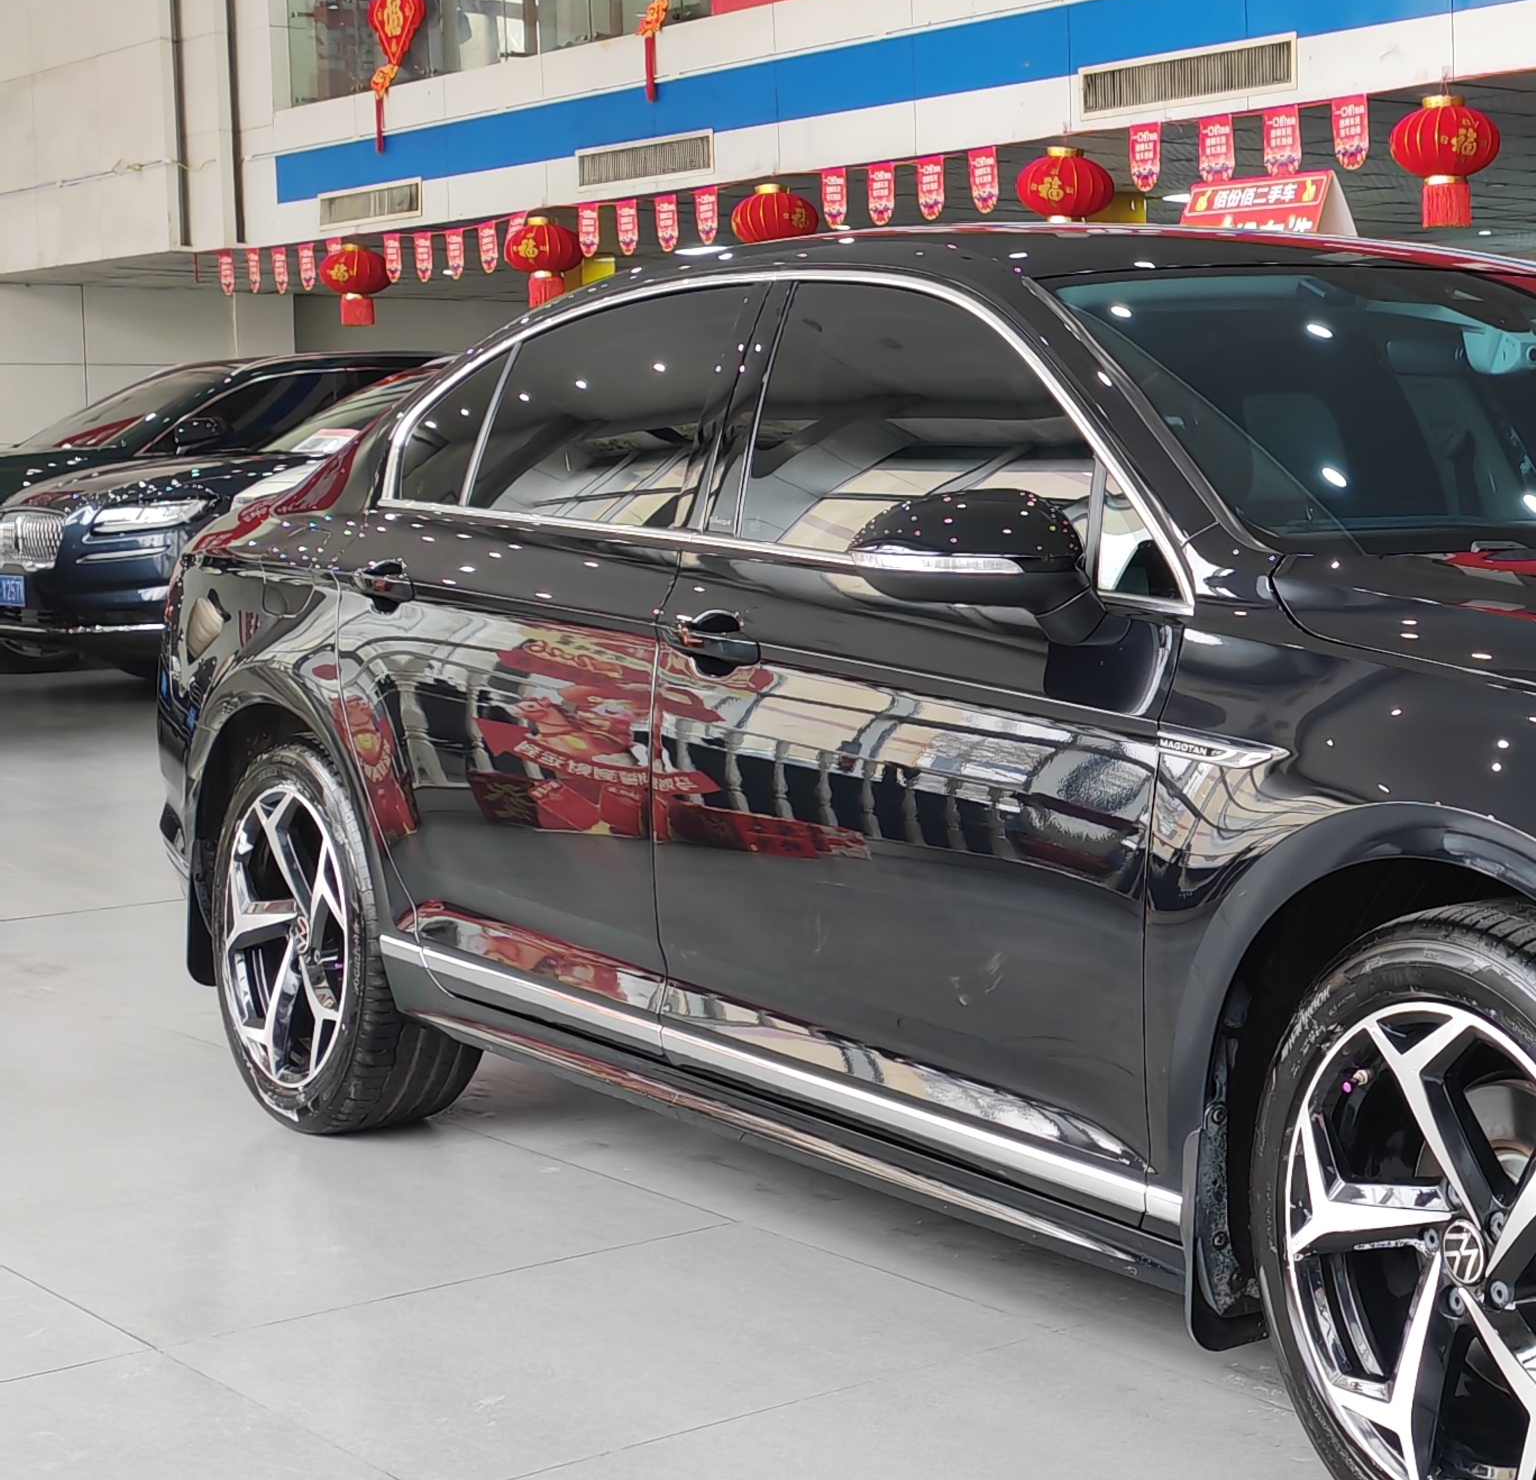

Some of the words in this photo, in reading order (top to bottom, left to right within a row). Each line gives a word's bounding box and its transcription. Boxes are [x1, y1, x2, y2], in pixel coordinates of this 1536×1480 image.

[1451, 128, 1477, 155] 福
[1213, 183, 1298, 209] 佰份佰二手车
[1159, 738, 1208, 756] MAGOTAN
